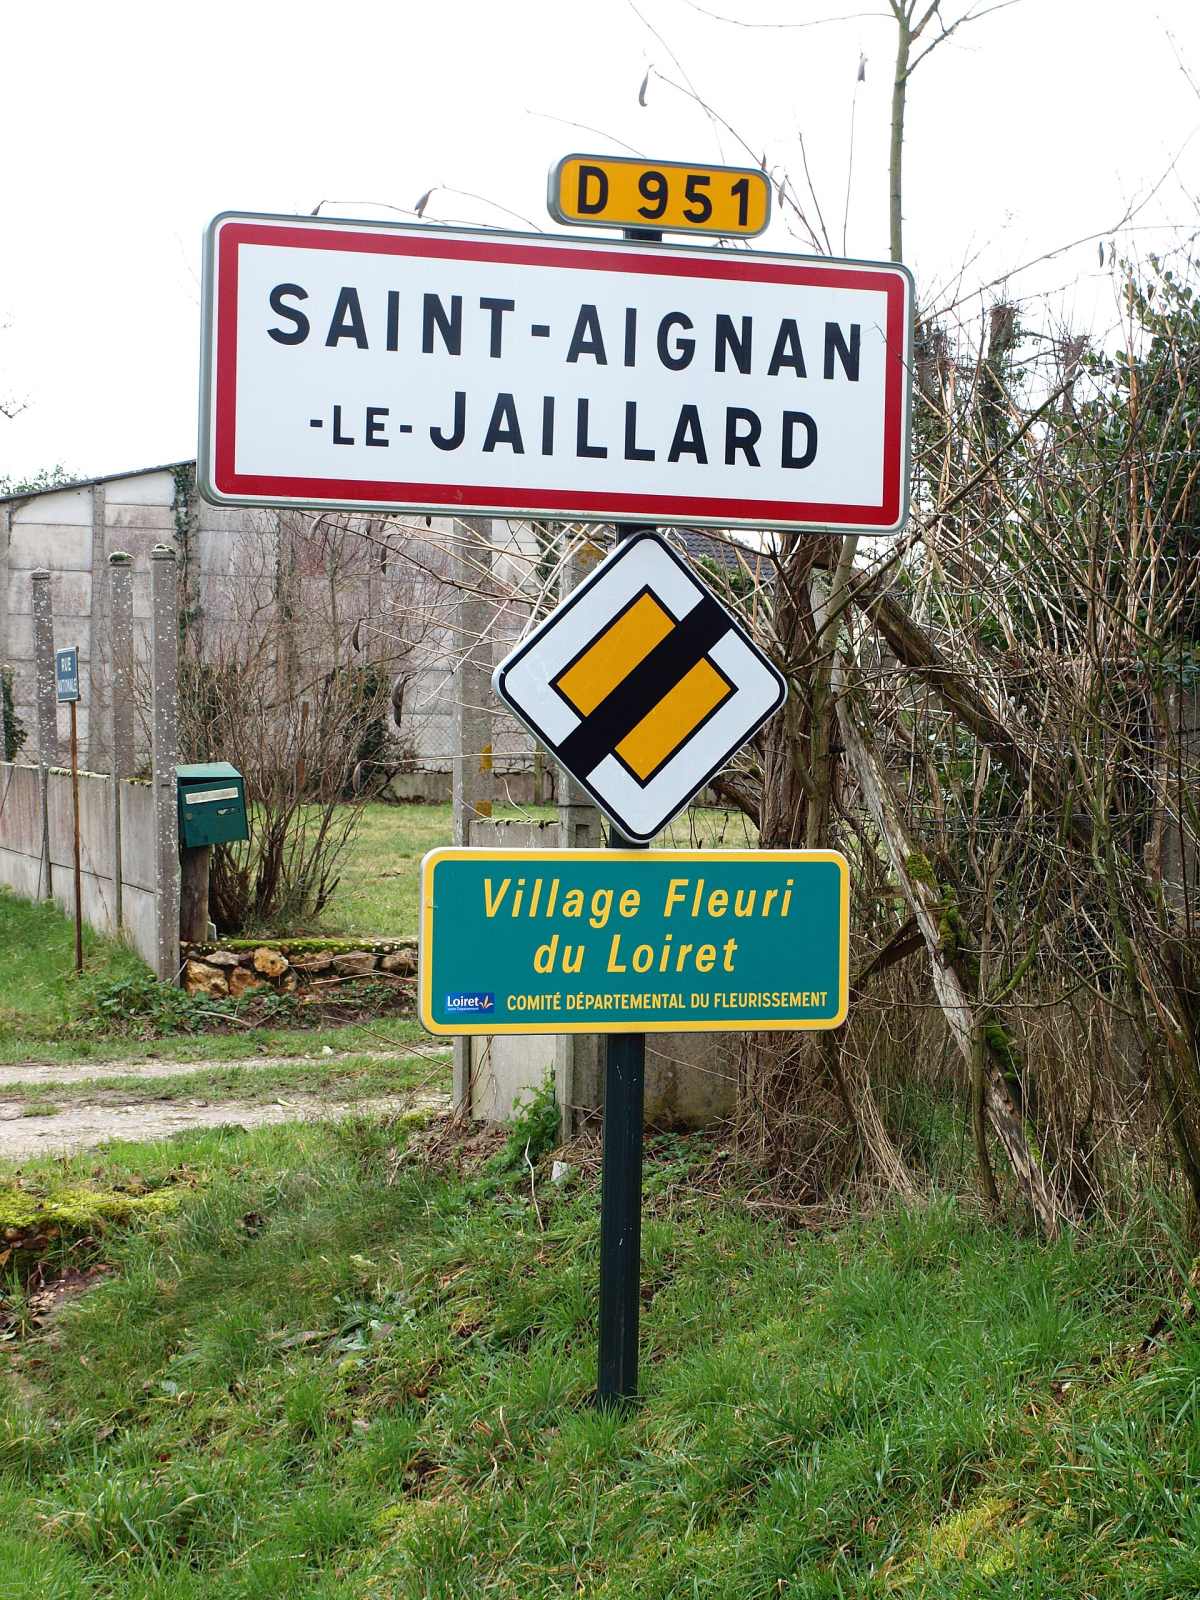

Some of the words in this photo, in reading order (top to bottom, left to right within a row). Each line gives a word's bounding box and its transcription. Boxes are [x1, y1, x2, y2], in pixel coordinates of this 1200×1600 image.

[577, 164, 610, 216] D
[636, 170, 750, 227] 951
[266, 282, 861, 382] SAINT-AIGNAN
[308, 391, 818, 470] -LE-JAILLARD
[484, 878, 641, 929] Village
[663, 878, 794, 918] Fleuri
[533, 934, 585, 974] du
[607, 933, 738, 974] Loiret
[447, 995, 480, 1007] Loiret
[507, 991, 562, 1011] COMITÉ
[566, 991, 686, 1010] DÉPARTEMENTAL
[690, 992, 710, 1009] DU
[713, 991, 828, 1008] FLEURISSEMENT
